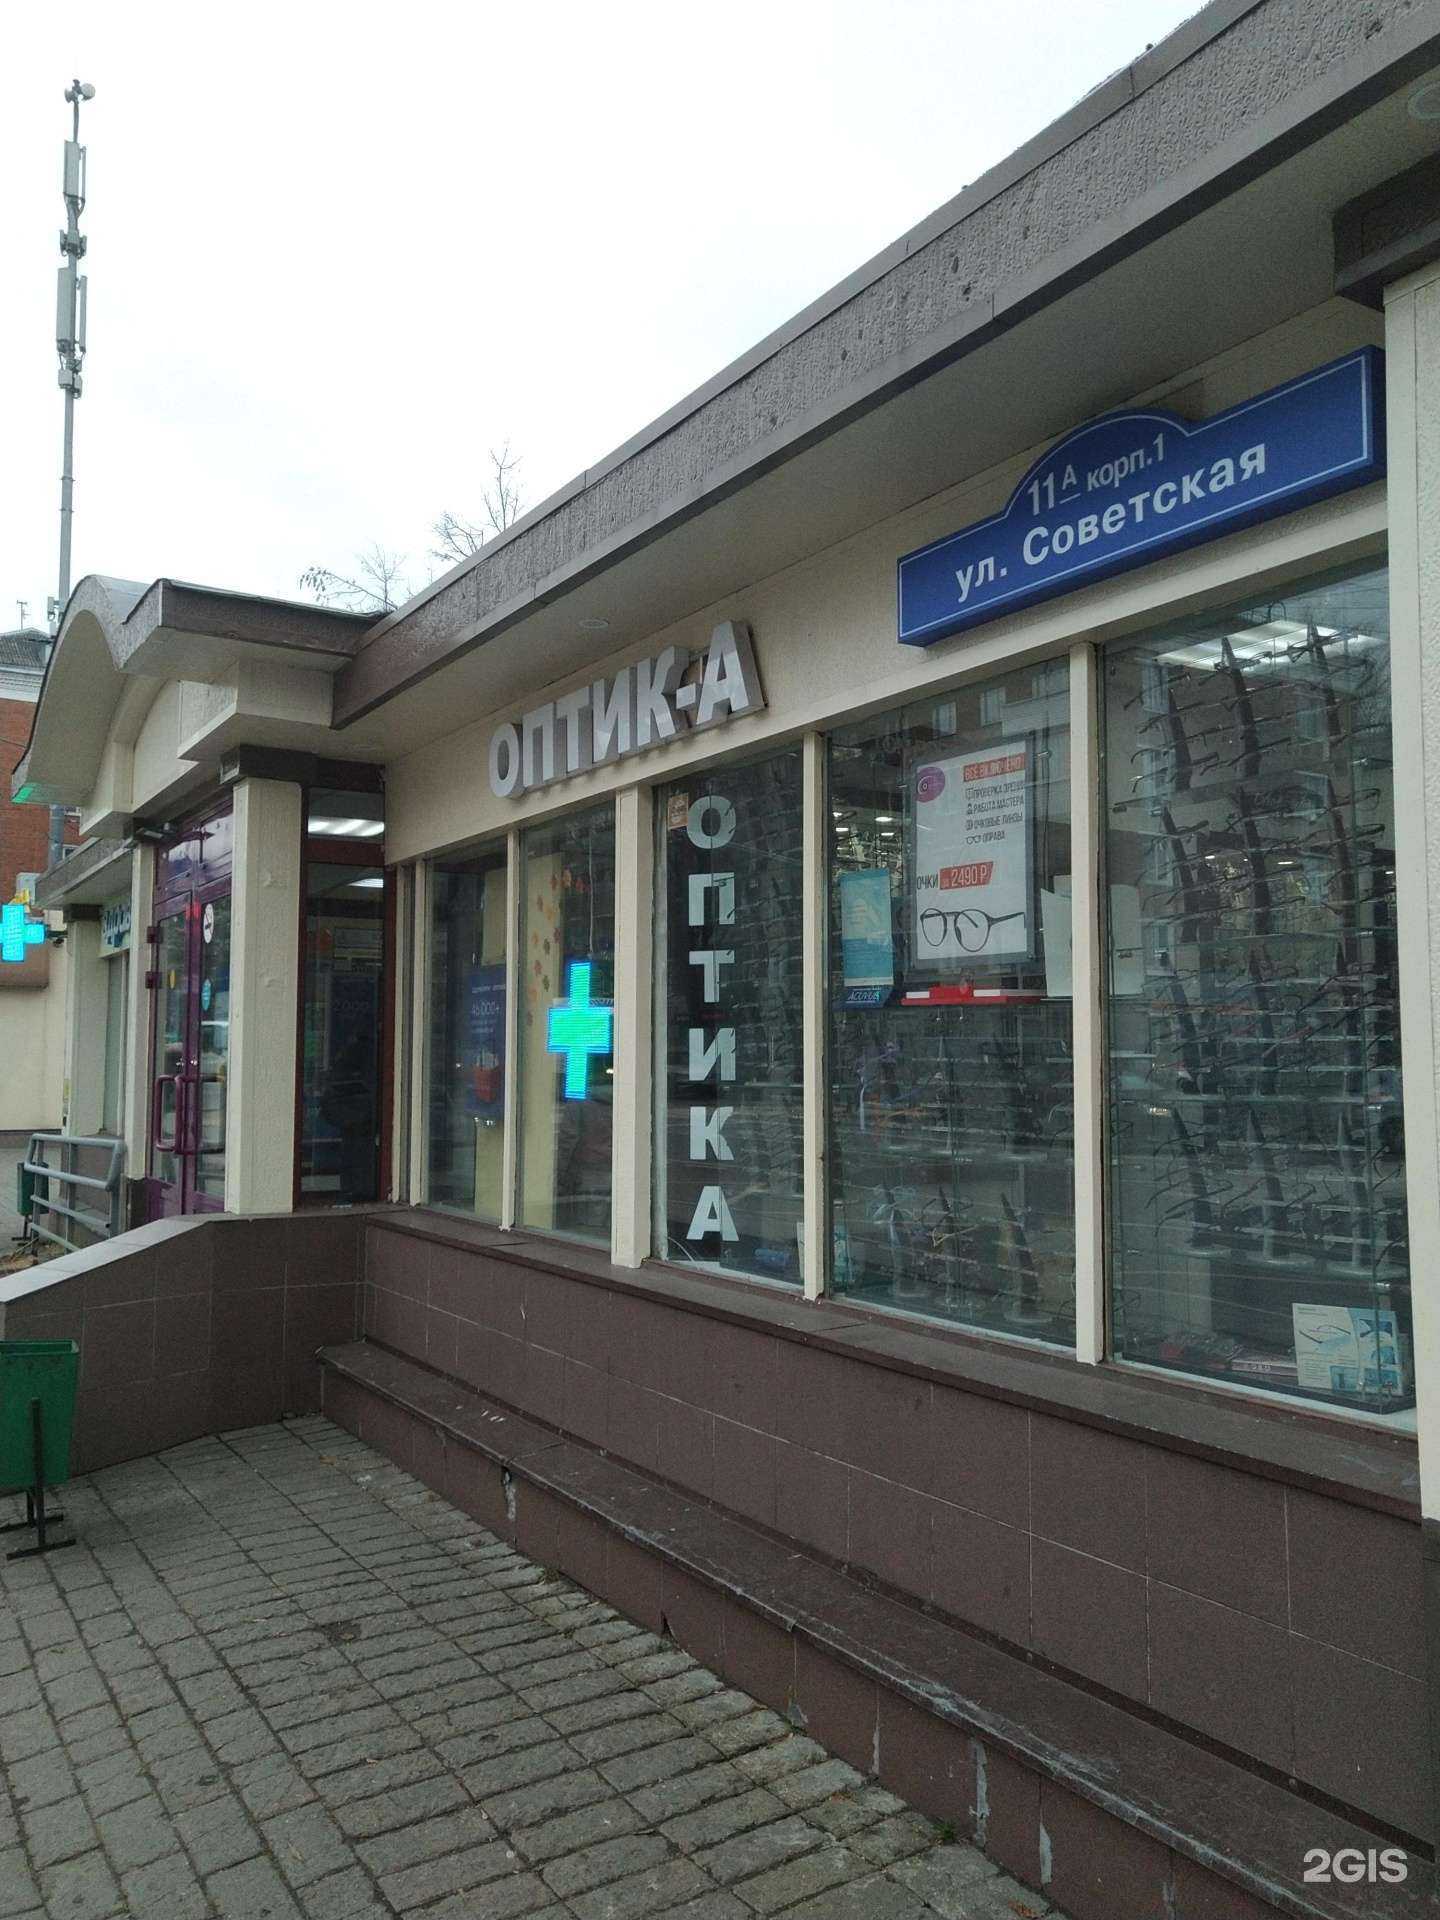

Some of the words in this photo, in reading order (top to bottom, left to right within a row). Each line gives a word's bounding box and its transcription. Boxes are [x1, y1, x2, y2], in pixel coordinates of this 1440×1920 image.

[1087, 433, 1165, 492] корп.1
[956, 557, 1008, 602] ул.
[1022, 443, 1266, 566] Советская
[917, 873, 938, 890] ОЧКИ
[951, 866, 978, 887] 2490
[686, 795, 739, 1241] ОПТИКА
